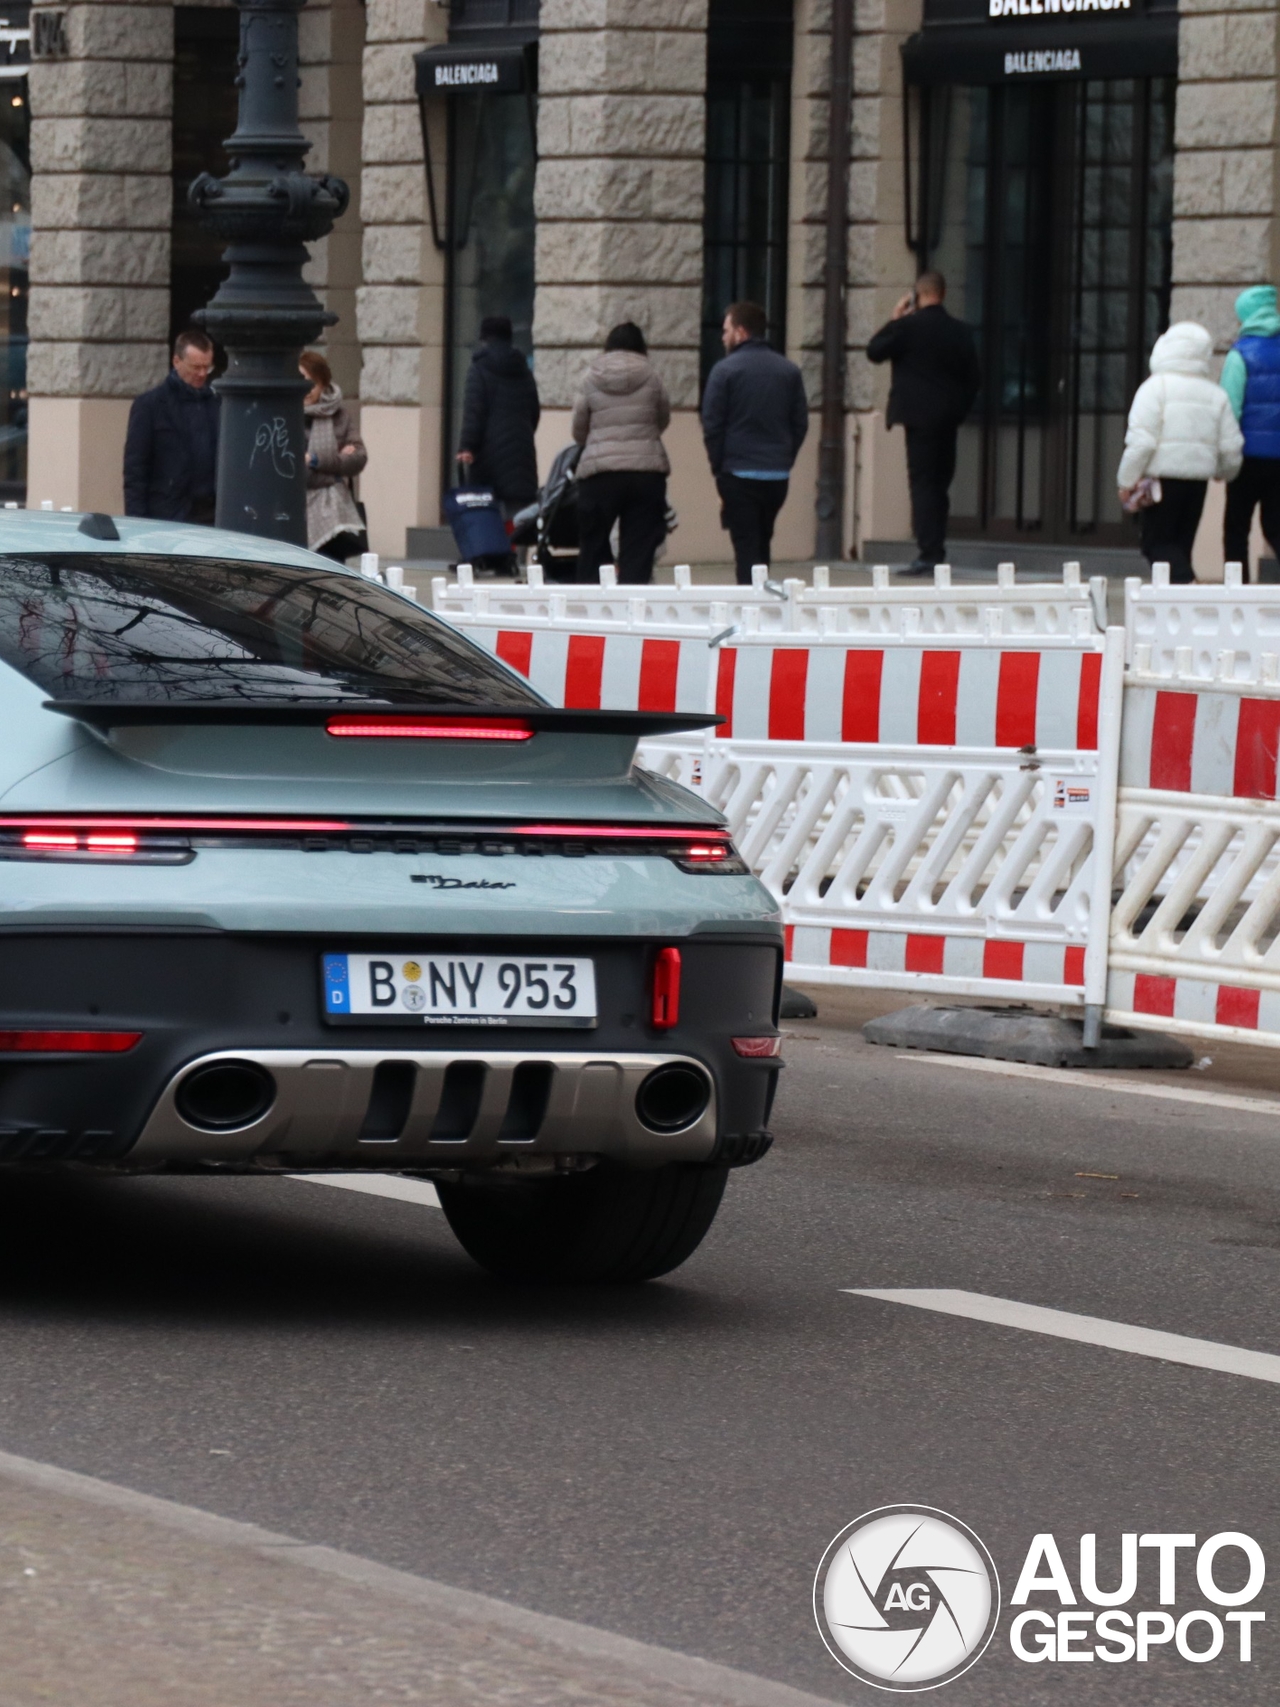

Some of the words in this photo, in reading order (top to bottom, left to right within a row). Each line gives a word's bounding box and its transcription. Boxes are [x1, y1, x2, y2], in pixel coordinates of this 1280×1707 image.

[1004, 49, 1082, 74] BALENCIAGA
[434, 62, 498, 86] BALENCIAGA
[332, 990, 344, 1004] D
[369, 961, 396, 1007] B
[429, 961, 484, 1008] NY
[498, 963, 577, 1010] 953
[424, 1016, 452, 1025] Porsche
[452, 1016, 479, 1025] Zentren
[480, 1017, 487, 1025] in
[488, 1017, 508, 1025] Berlin
